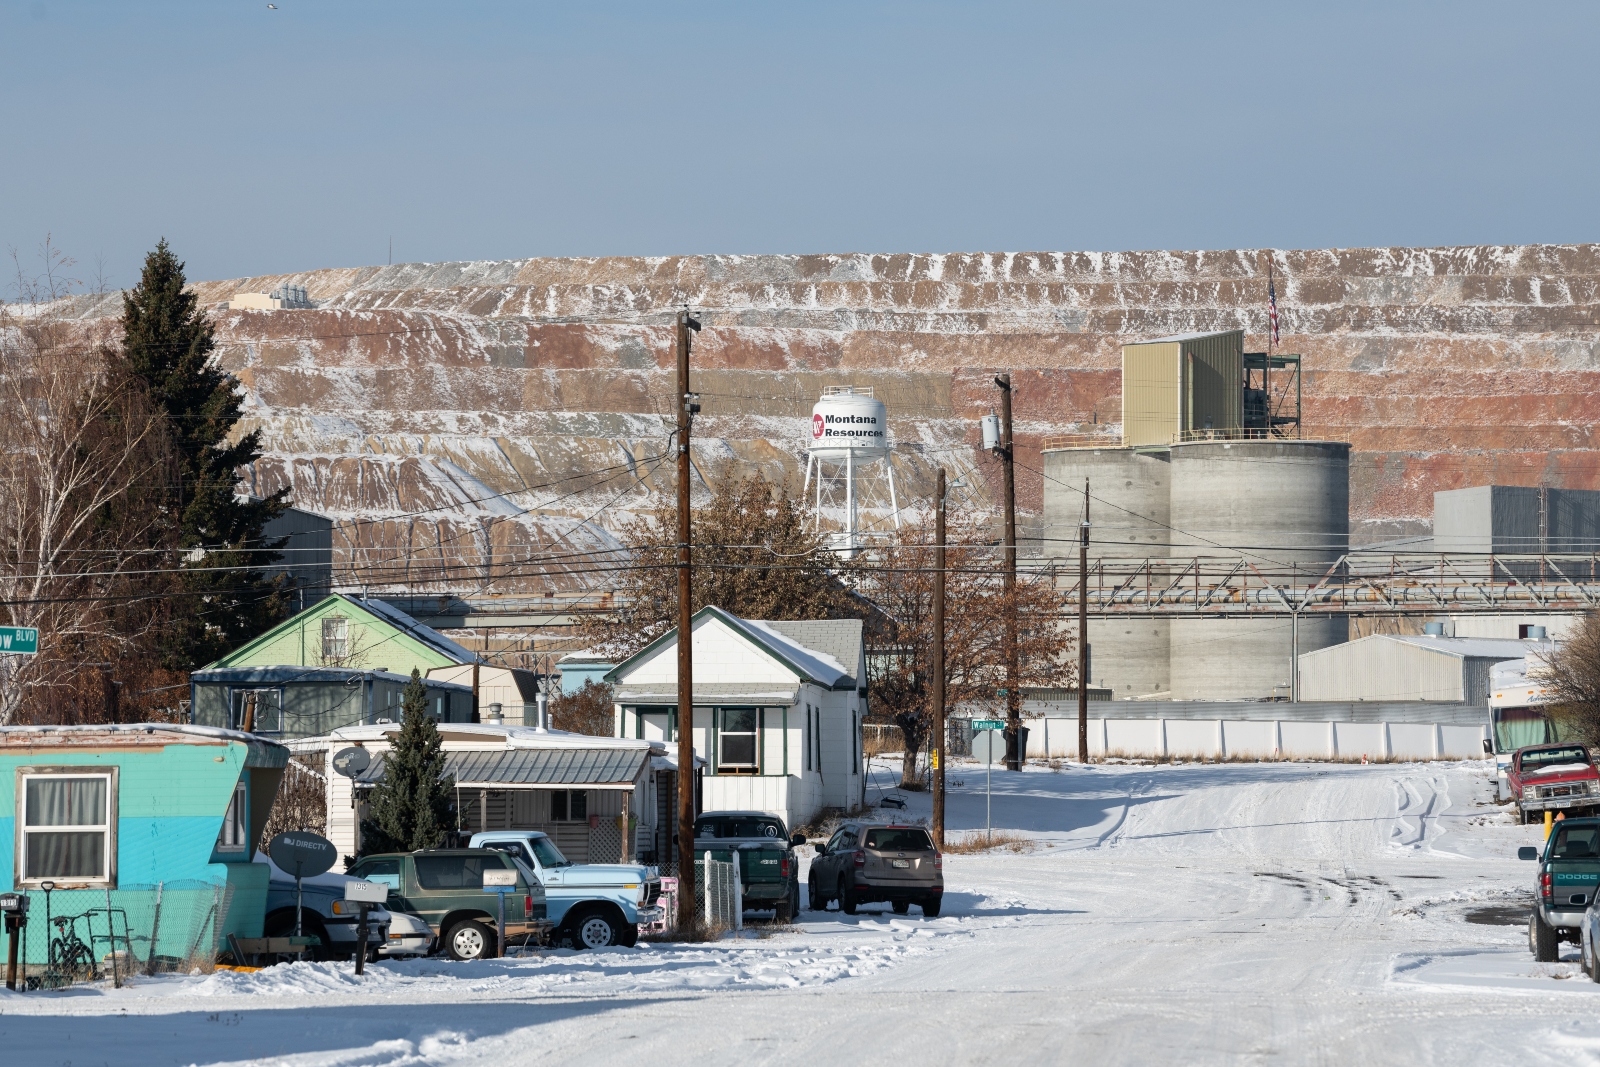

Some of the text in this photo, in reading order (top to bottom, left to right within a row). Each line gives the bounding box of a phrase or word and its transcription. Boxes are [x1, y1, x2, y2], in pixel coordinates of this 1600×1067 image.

[825, 414, 877, 424] Montana
[825, 428, 884, 437] Resources
[15, 629, 35, 642] BLVD
[973, 721, 996, 729] Walnut
[295, 839, 327, 851] DIRECTV
